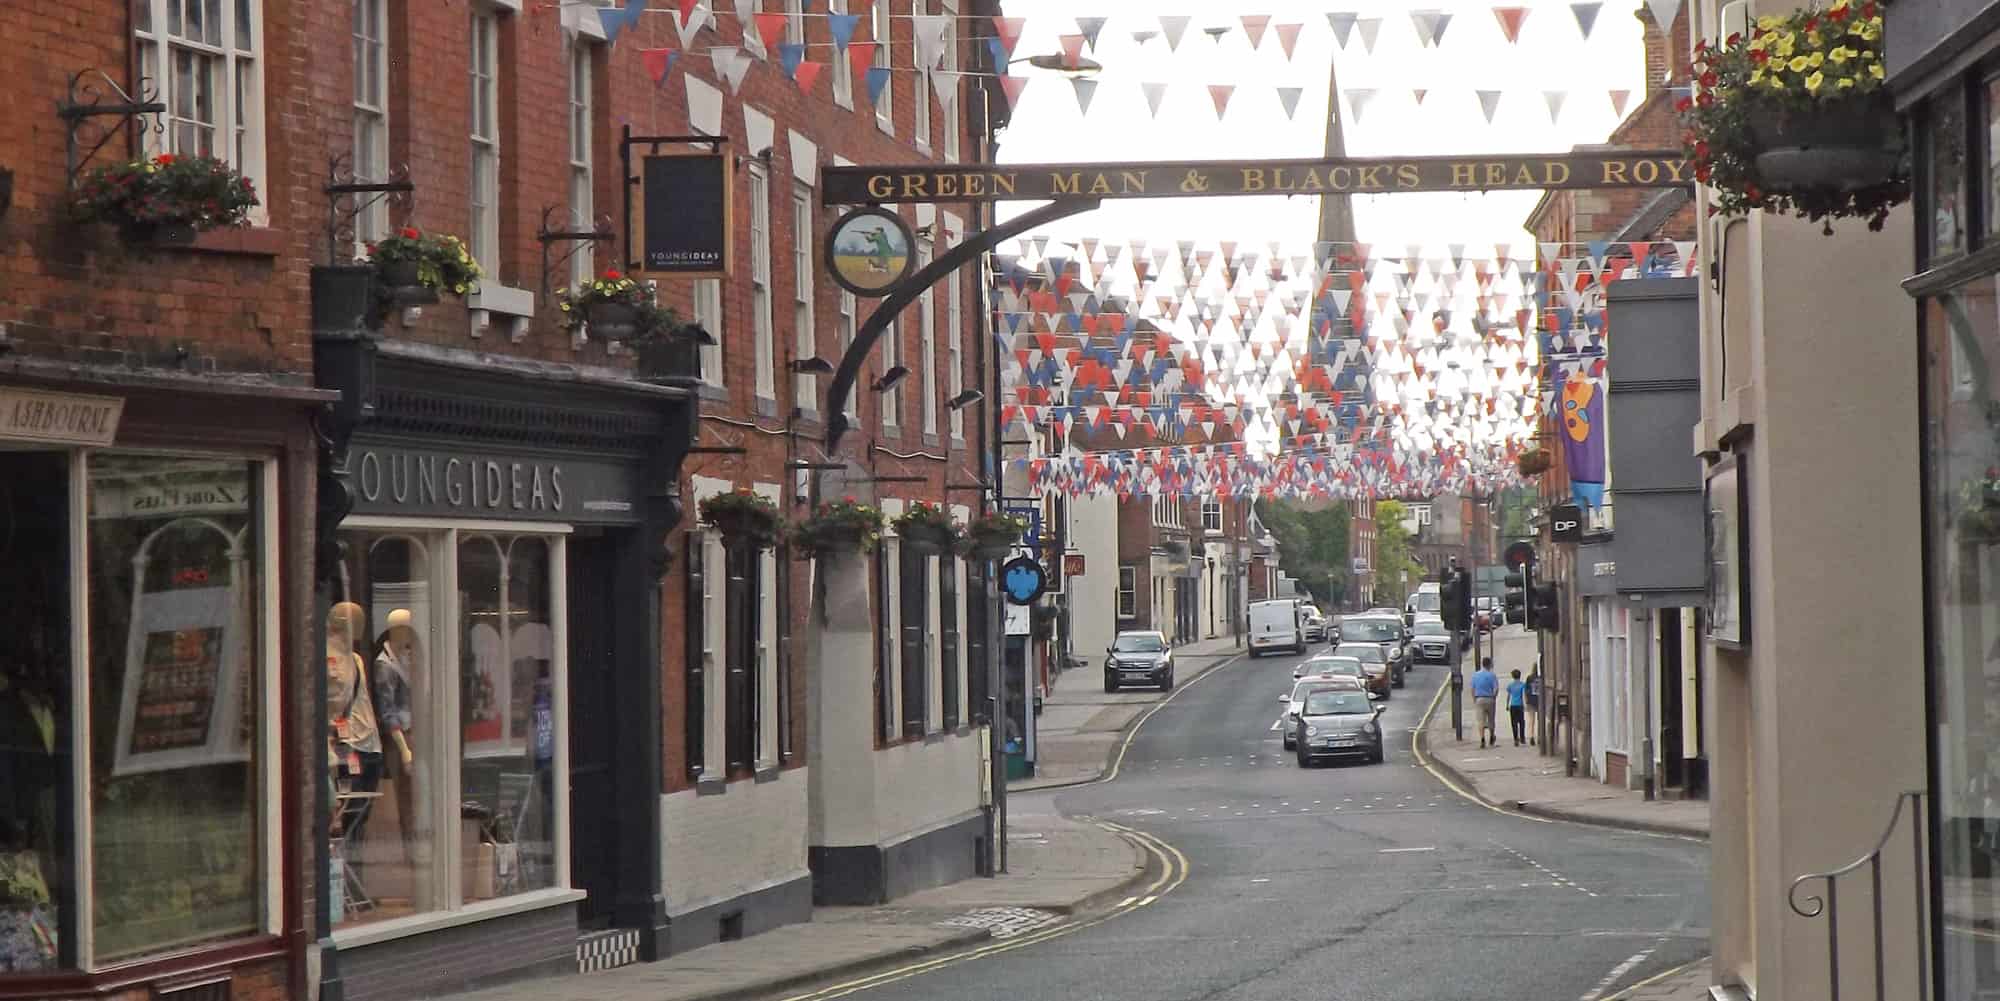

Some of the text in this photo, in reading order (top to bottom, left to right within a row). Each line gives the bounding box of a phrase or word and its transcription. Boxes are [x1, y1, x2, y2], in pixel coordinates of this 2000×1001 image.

[867, 172, 1017, 199] GREEN
[1050, 170, 1148, 195] MAN
[1179, 169, 1209, 193] &
[1239, 163, 1422, 192] BLACK'S
[1449, 161, 1570, 186] HEAD
[651, 252, 719, 260] YOUNGIDEAS
[8, 399, 112, 433] ASHBOURNE
